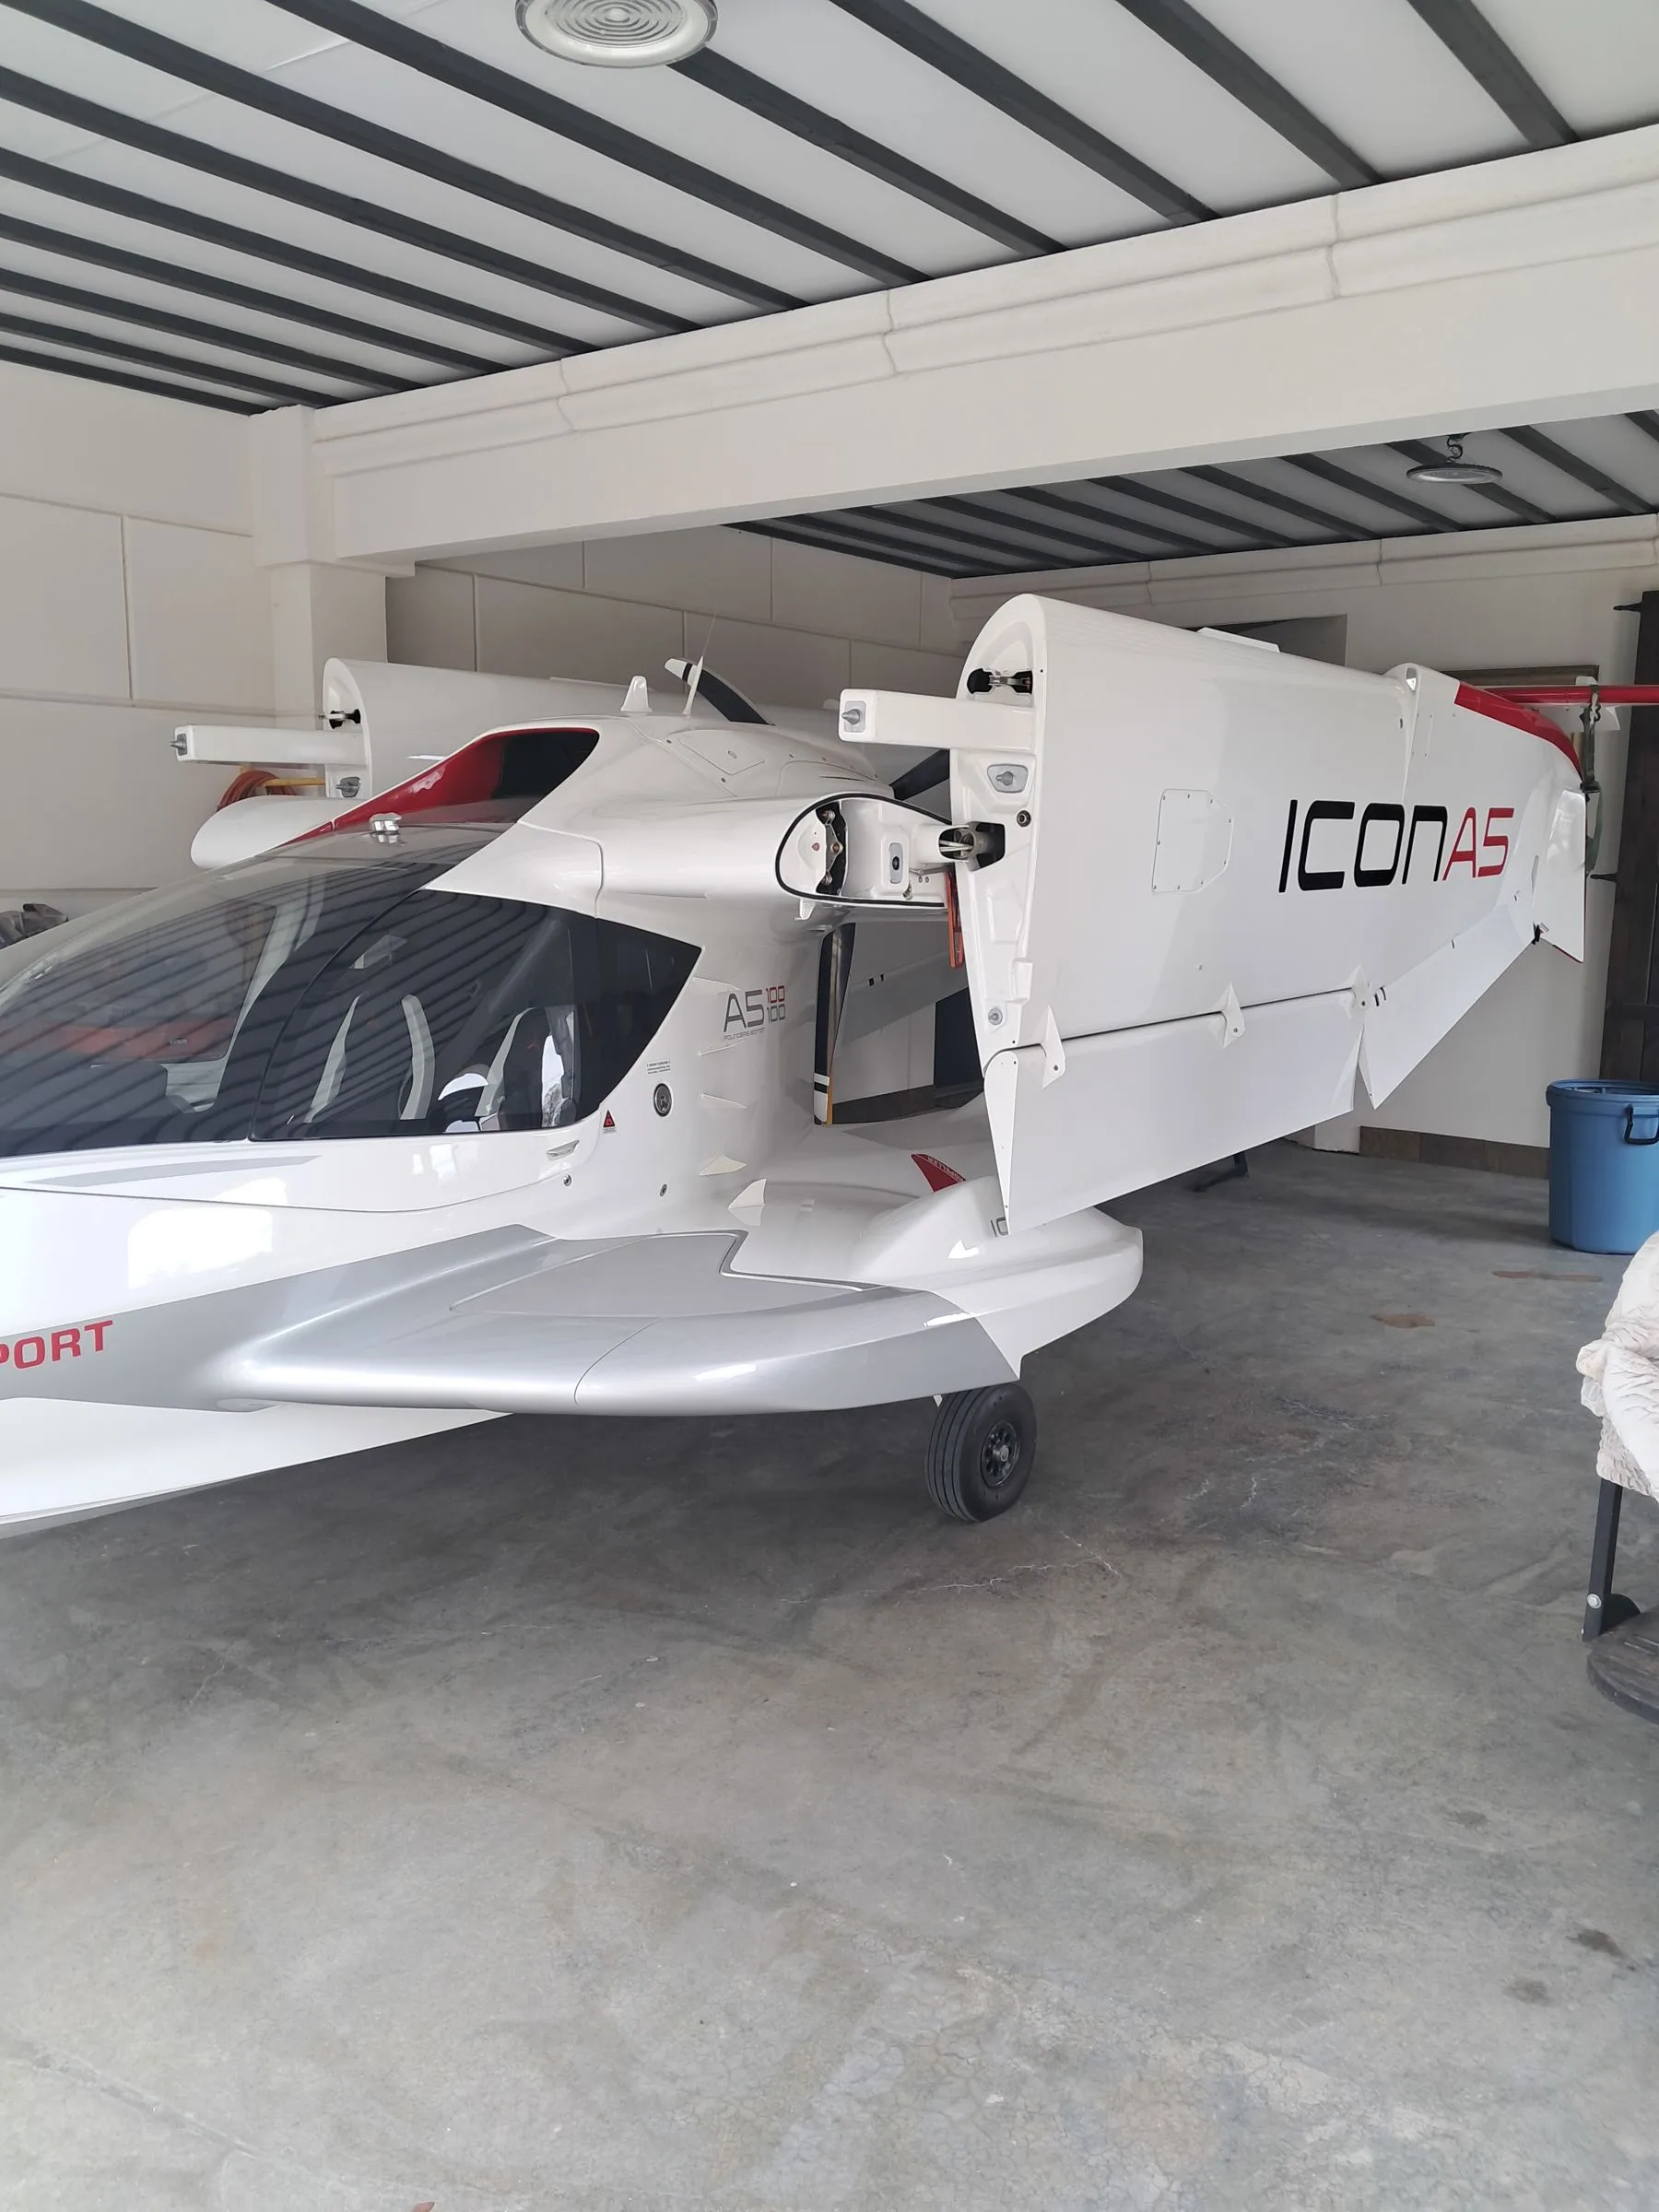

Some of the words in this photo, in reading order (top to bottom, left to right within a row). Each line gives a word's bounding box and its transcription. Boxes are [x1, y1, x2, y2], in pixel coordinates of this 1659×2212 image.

[765, 985, 785, 1004] 100
[723, 989, 765, 1033] A5
[766, 1004, 786, 1023] 100
